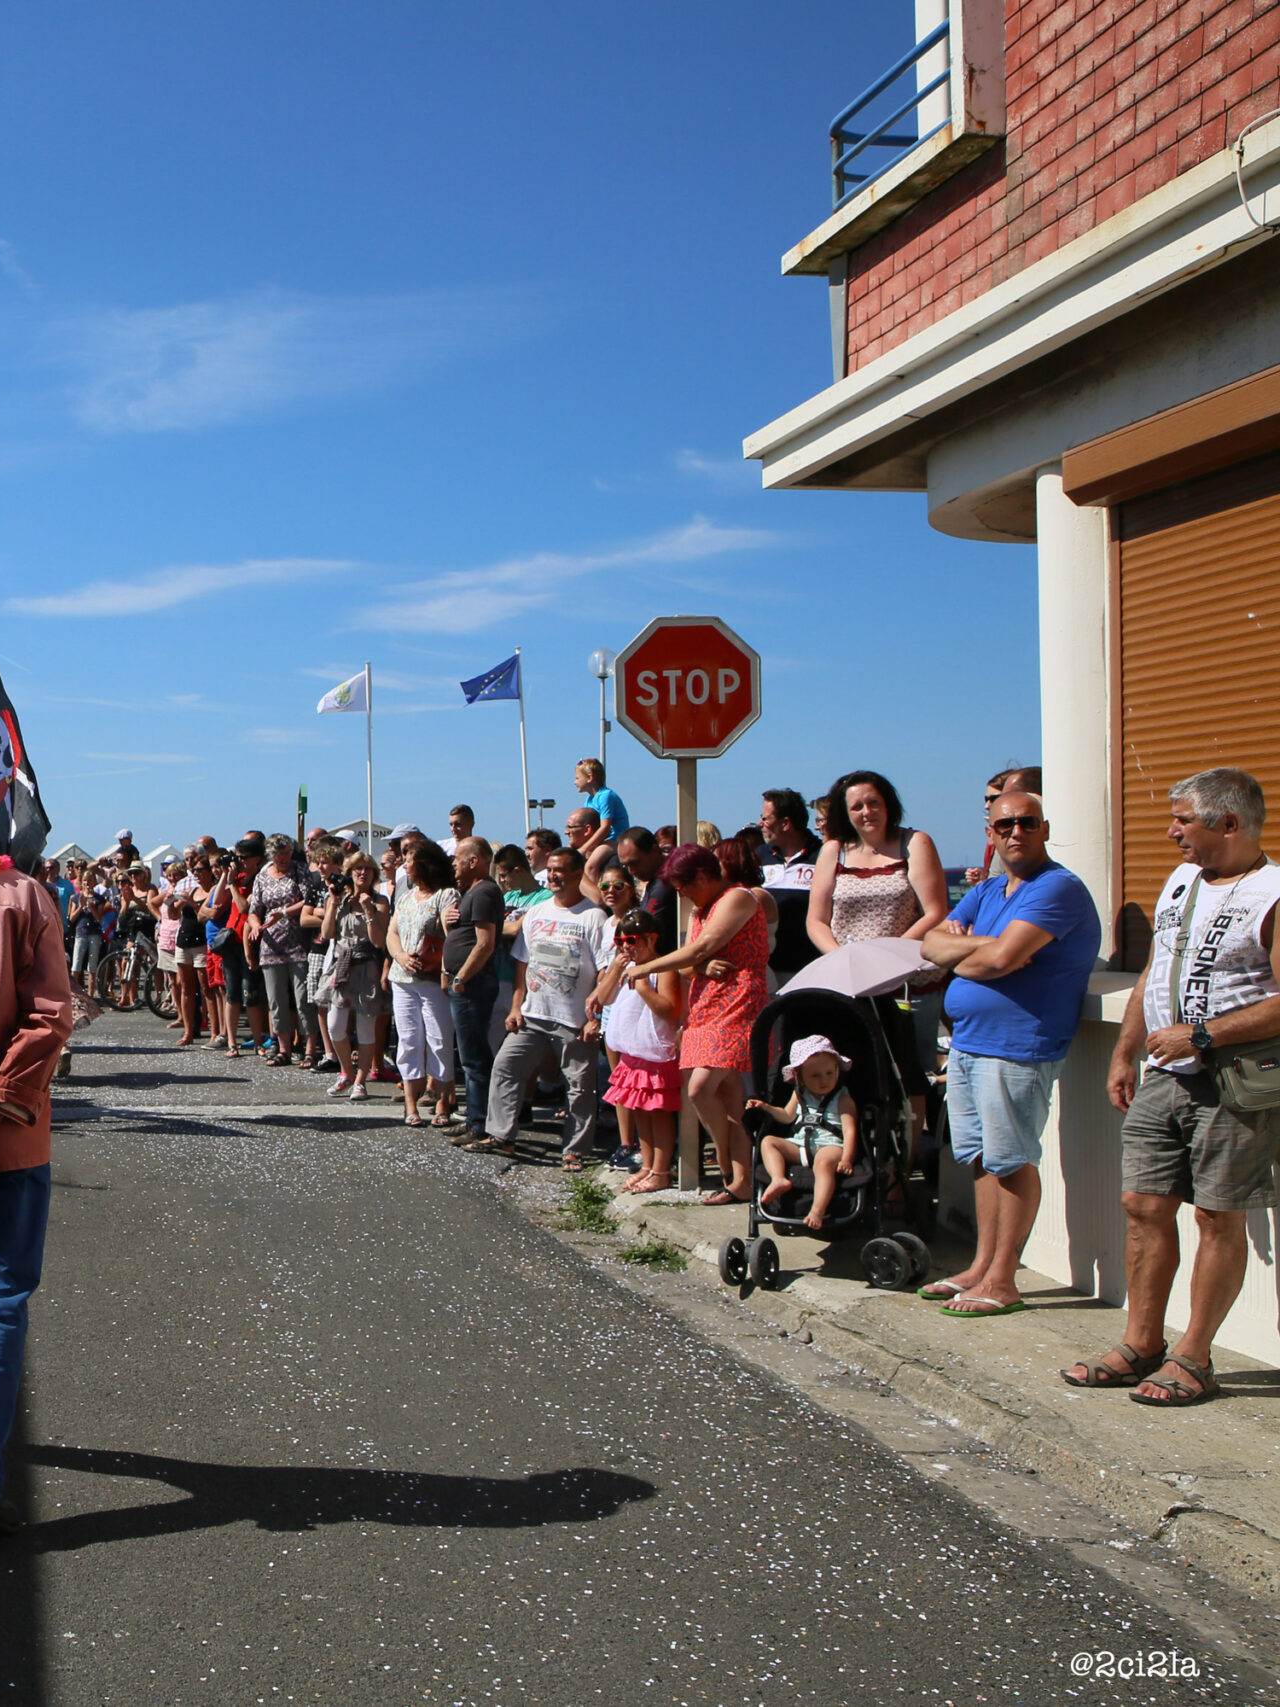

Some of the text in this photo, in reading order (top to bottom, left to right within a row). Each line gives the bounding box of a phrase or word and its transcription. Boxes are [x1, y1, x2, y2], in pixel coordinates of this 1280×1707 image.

[636, 668, 741, 706] STOP
[797, 867, 814, 880] 10
[530, 920, 558, 939] 24
